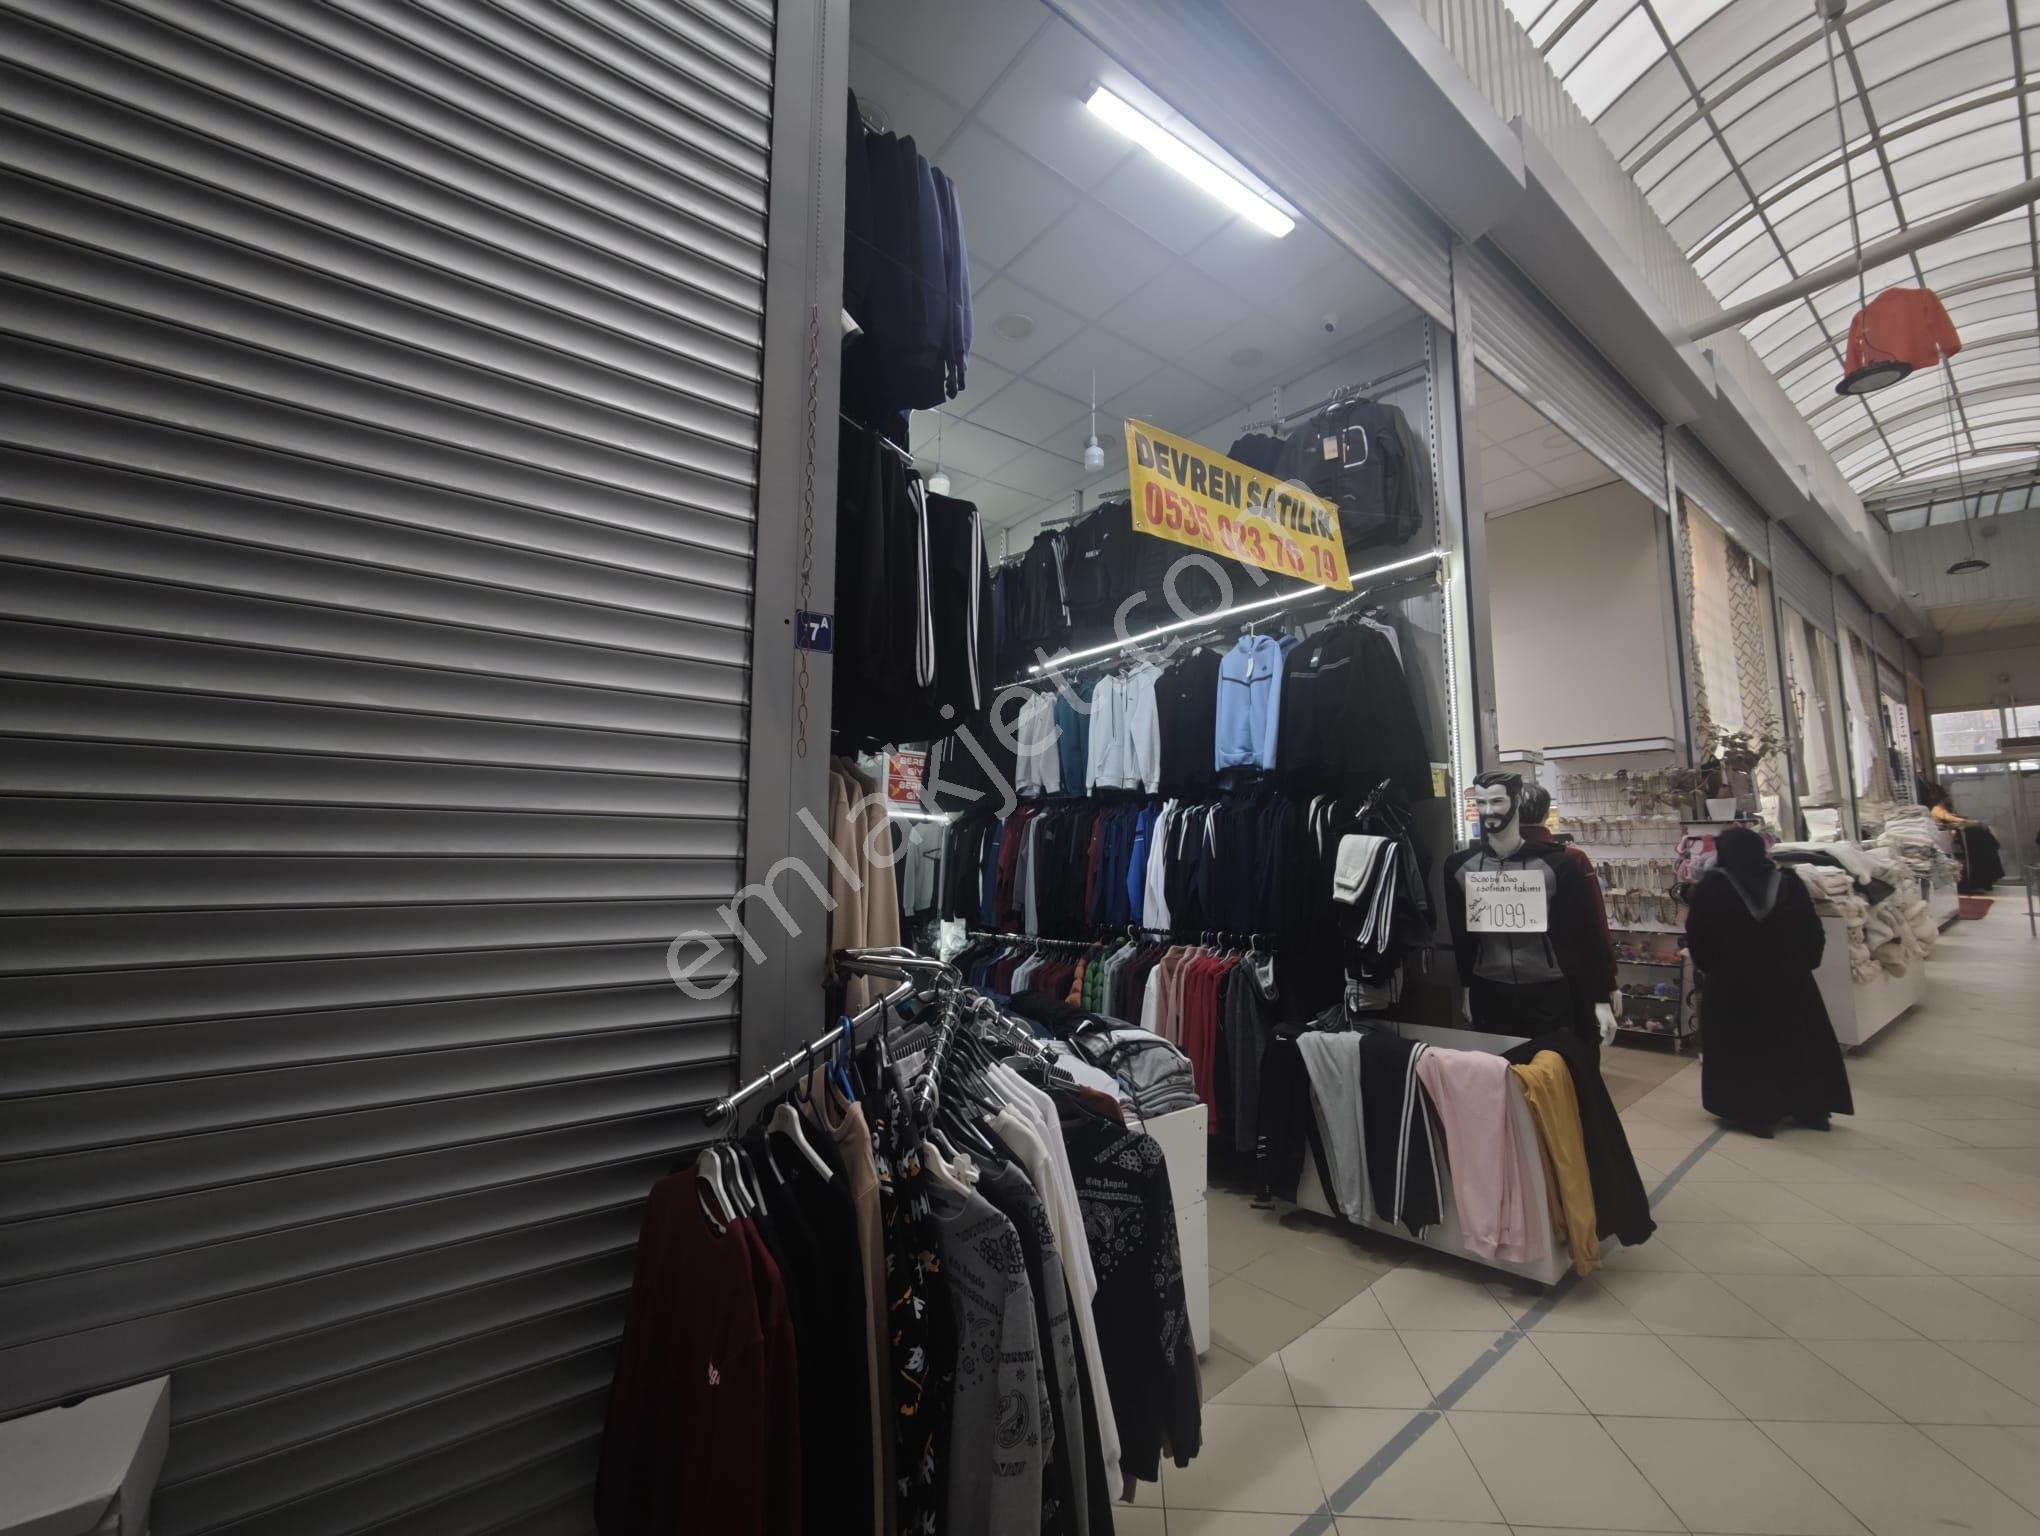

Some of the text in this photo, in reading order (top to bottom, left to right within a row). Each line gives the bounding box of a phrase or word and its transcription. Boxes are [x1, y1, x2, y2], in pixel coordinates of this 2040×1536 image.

[1135, 431, 1335, 541] DEVREN SATILIK
[1145, 481, 1215, 542] 0535
[1310, 544, 1339, 582] 19
[1489, 903, 1526, 928] 1099
